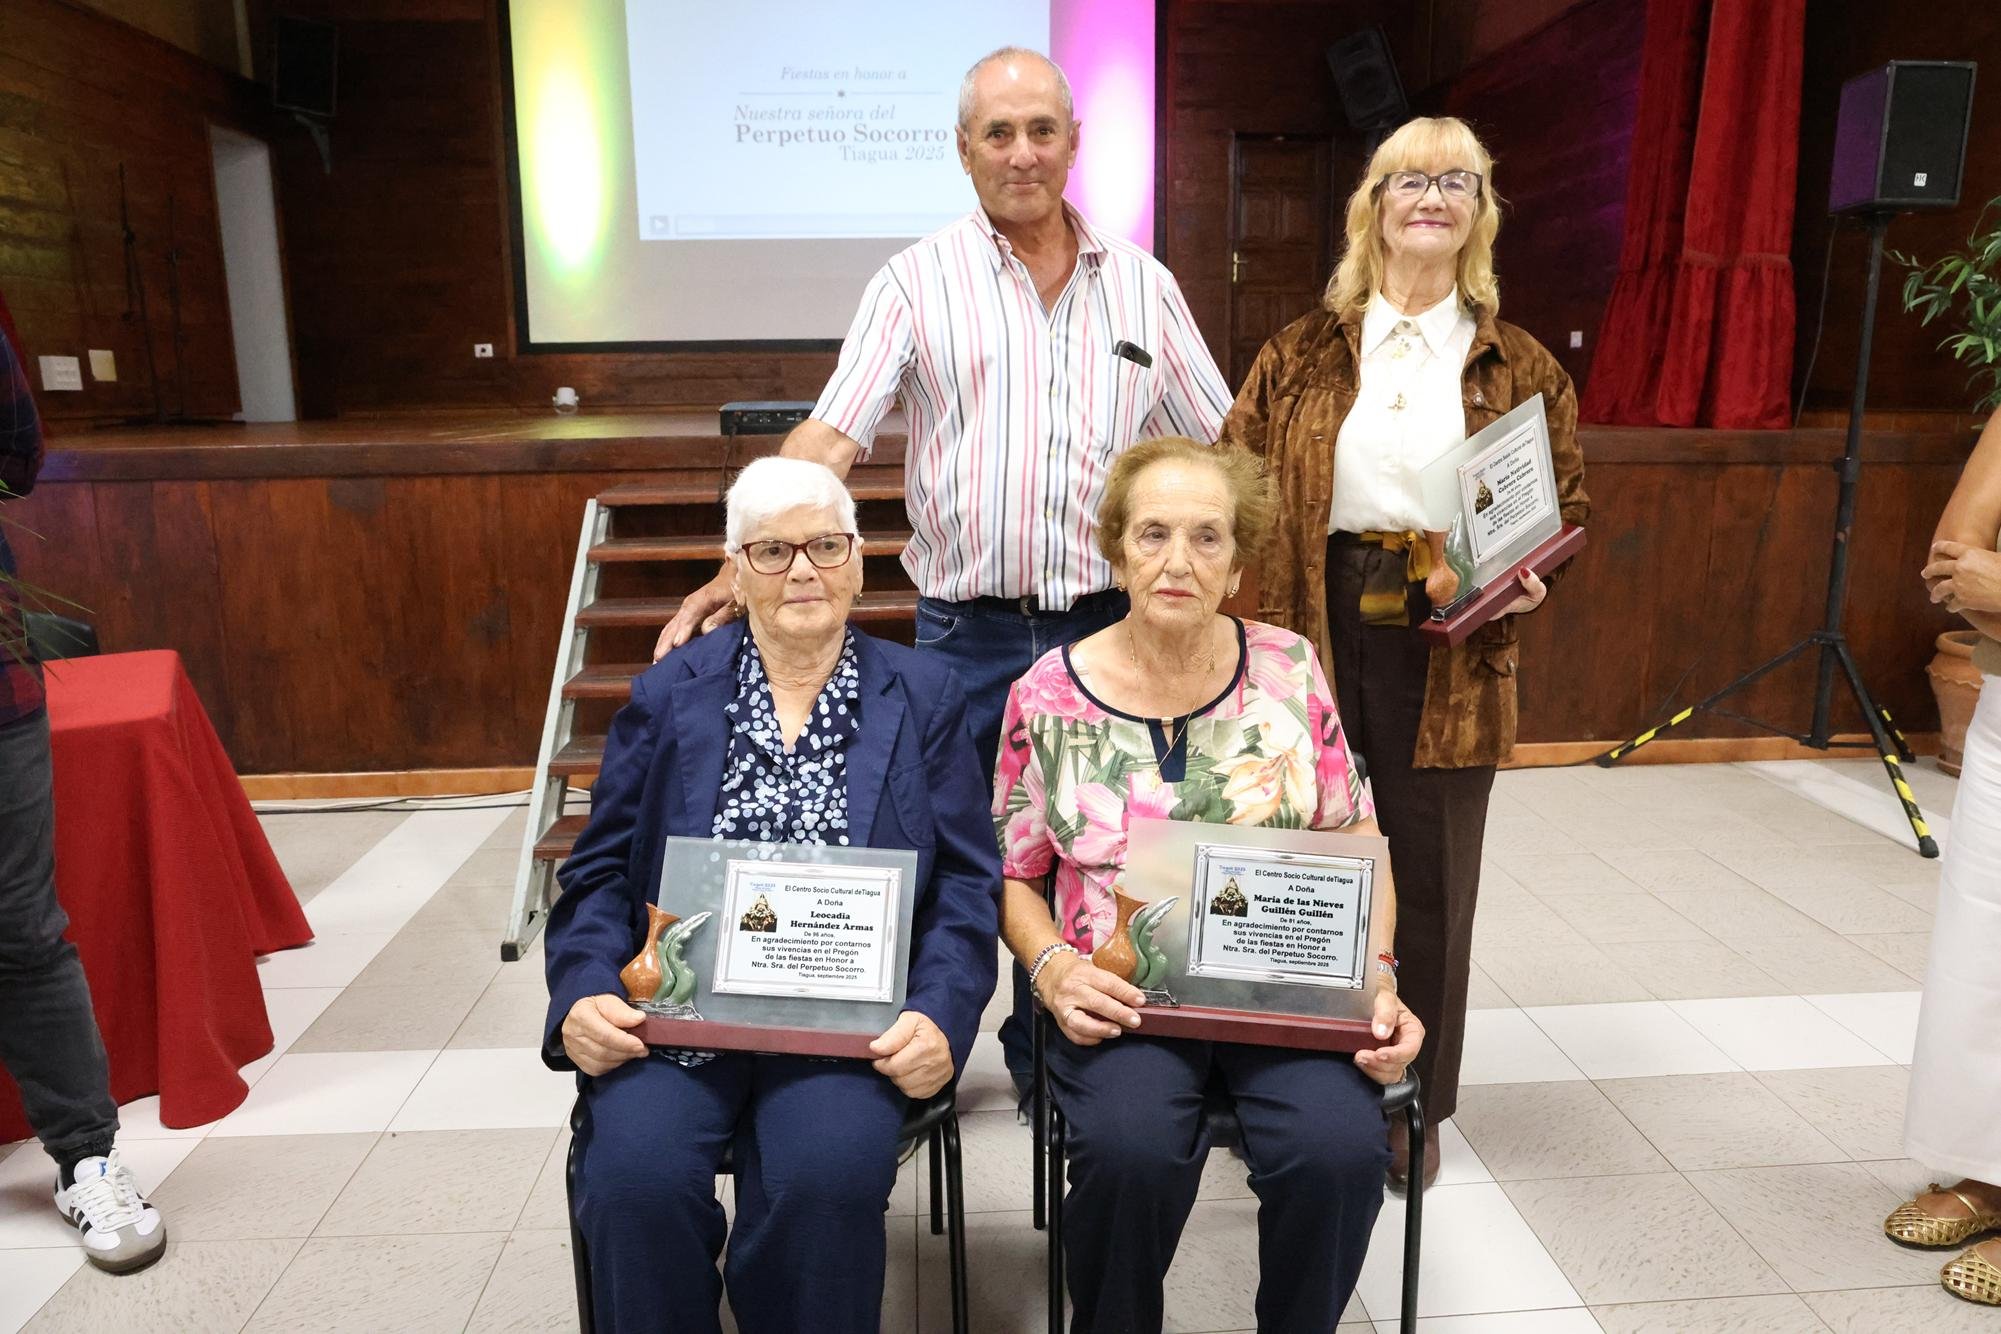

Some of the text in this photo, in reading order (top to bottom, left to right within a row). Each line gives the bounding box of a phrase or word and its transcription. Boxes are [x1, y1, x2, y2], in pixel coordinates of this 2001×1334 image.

[780, 66, 907, 80] Fiestas en honor a
[734, 104, 896, 122] Nuestra señora del
[735, 123, 948, 147] Perpetuo Socorro
[839, 145, 945, 164] Tiagua 2025
[1302, 874, 1325, 882] Cultural
[1312, 900, 1344, 909] Nieves
[810, 911, 851, 920] Leocadia
[1261, 906, 1334, 918] Guillén Guillén
[790, 920, 874, 931] Hernández Armas
[1234, 922, 1290, 931] agradecimiento
[1306, 928, 1344, 936] contarnos
[1249, 930, 1283, 940] vivencias
[1304, 935, 1331, 944] Pregón
[1260, 940, 1284, 948] fiestas
[1298, 943, 1320, 951] Honor
[1272, 949, 1305, 958] Perpetuo
[800, 964, 834, 972] Perpetuo
